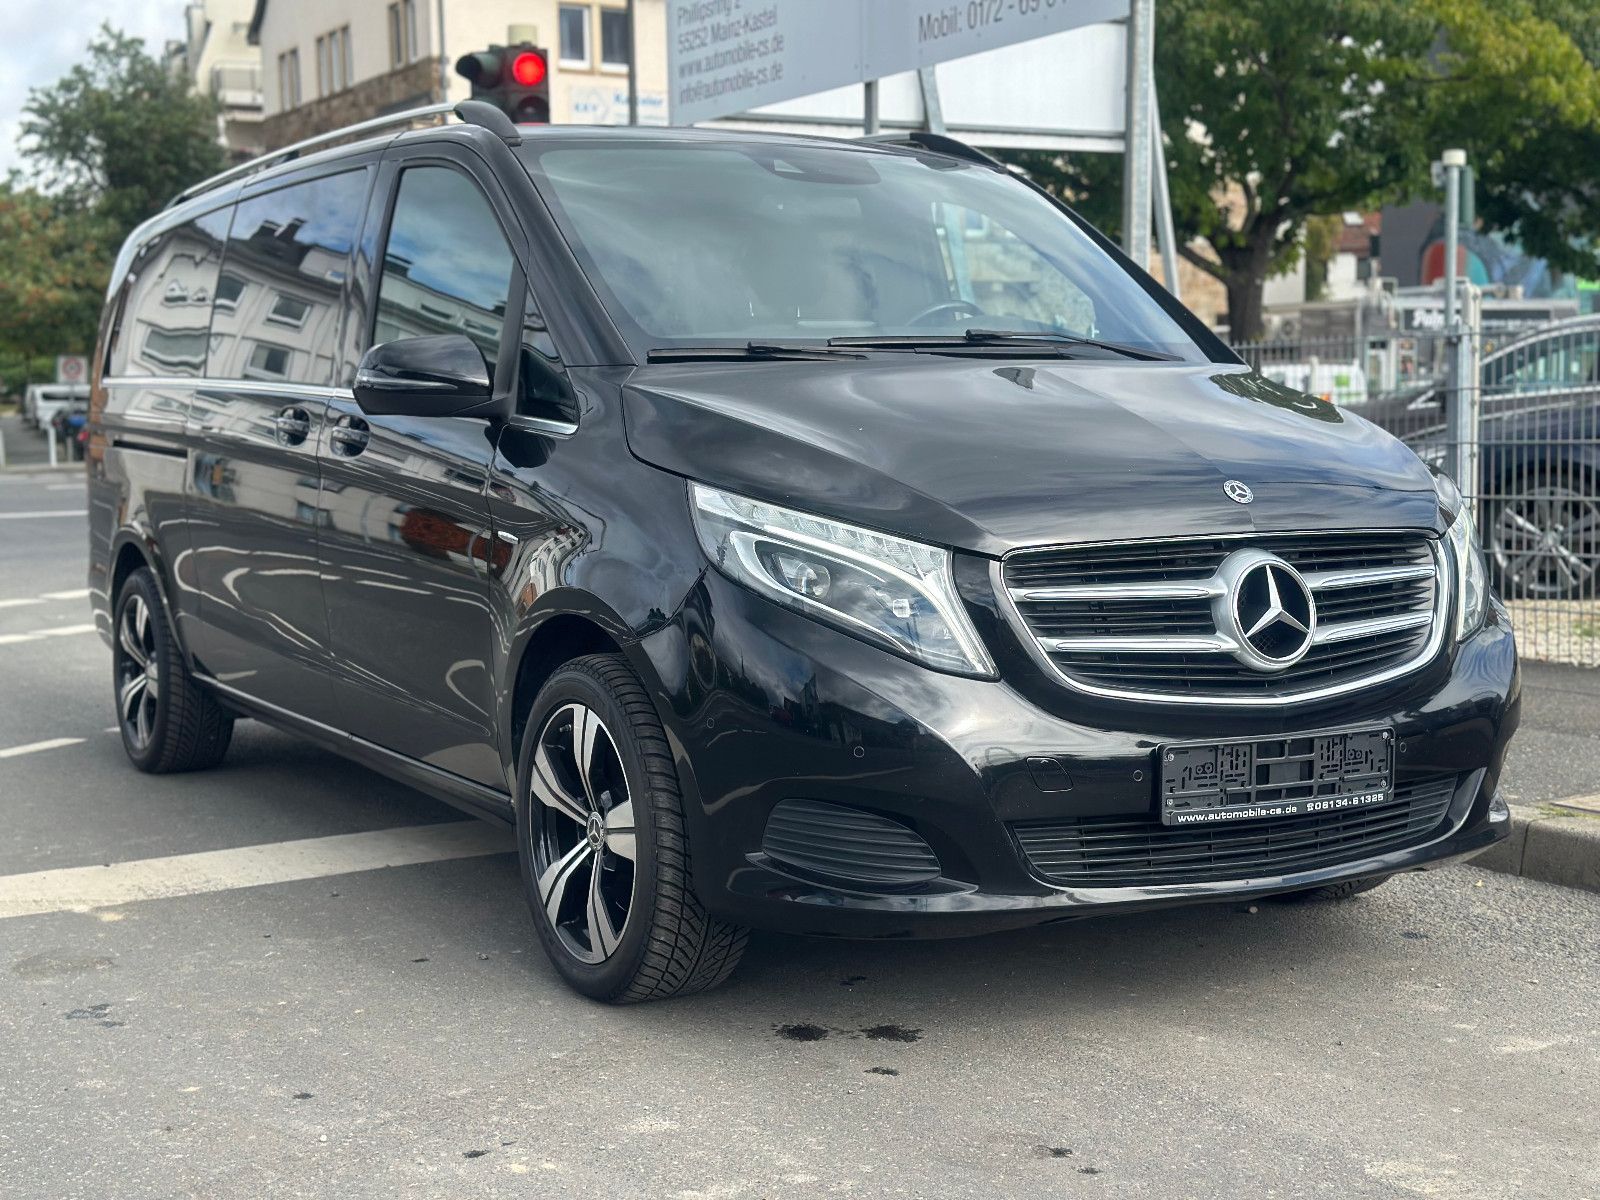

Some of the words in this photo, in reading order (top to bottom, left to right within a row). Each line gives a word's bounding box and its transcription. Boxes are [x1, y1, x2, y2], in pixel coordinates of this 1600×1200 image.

[918, 5, 963, 42] Mobil:
[966, 0, 1003, 29] 0172
[1177, 805, 1298, 823] www.automobile-cs.de
